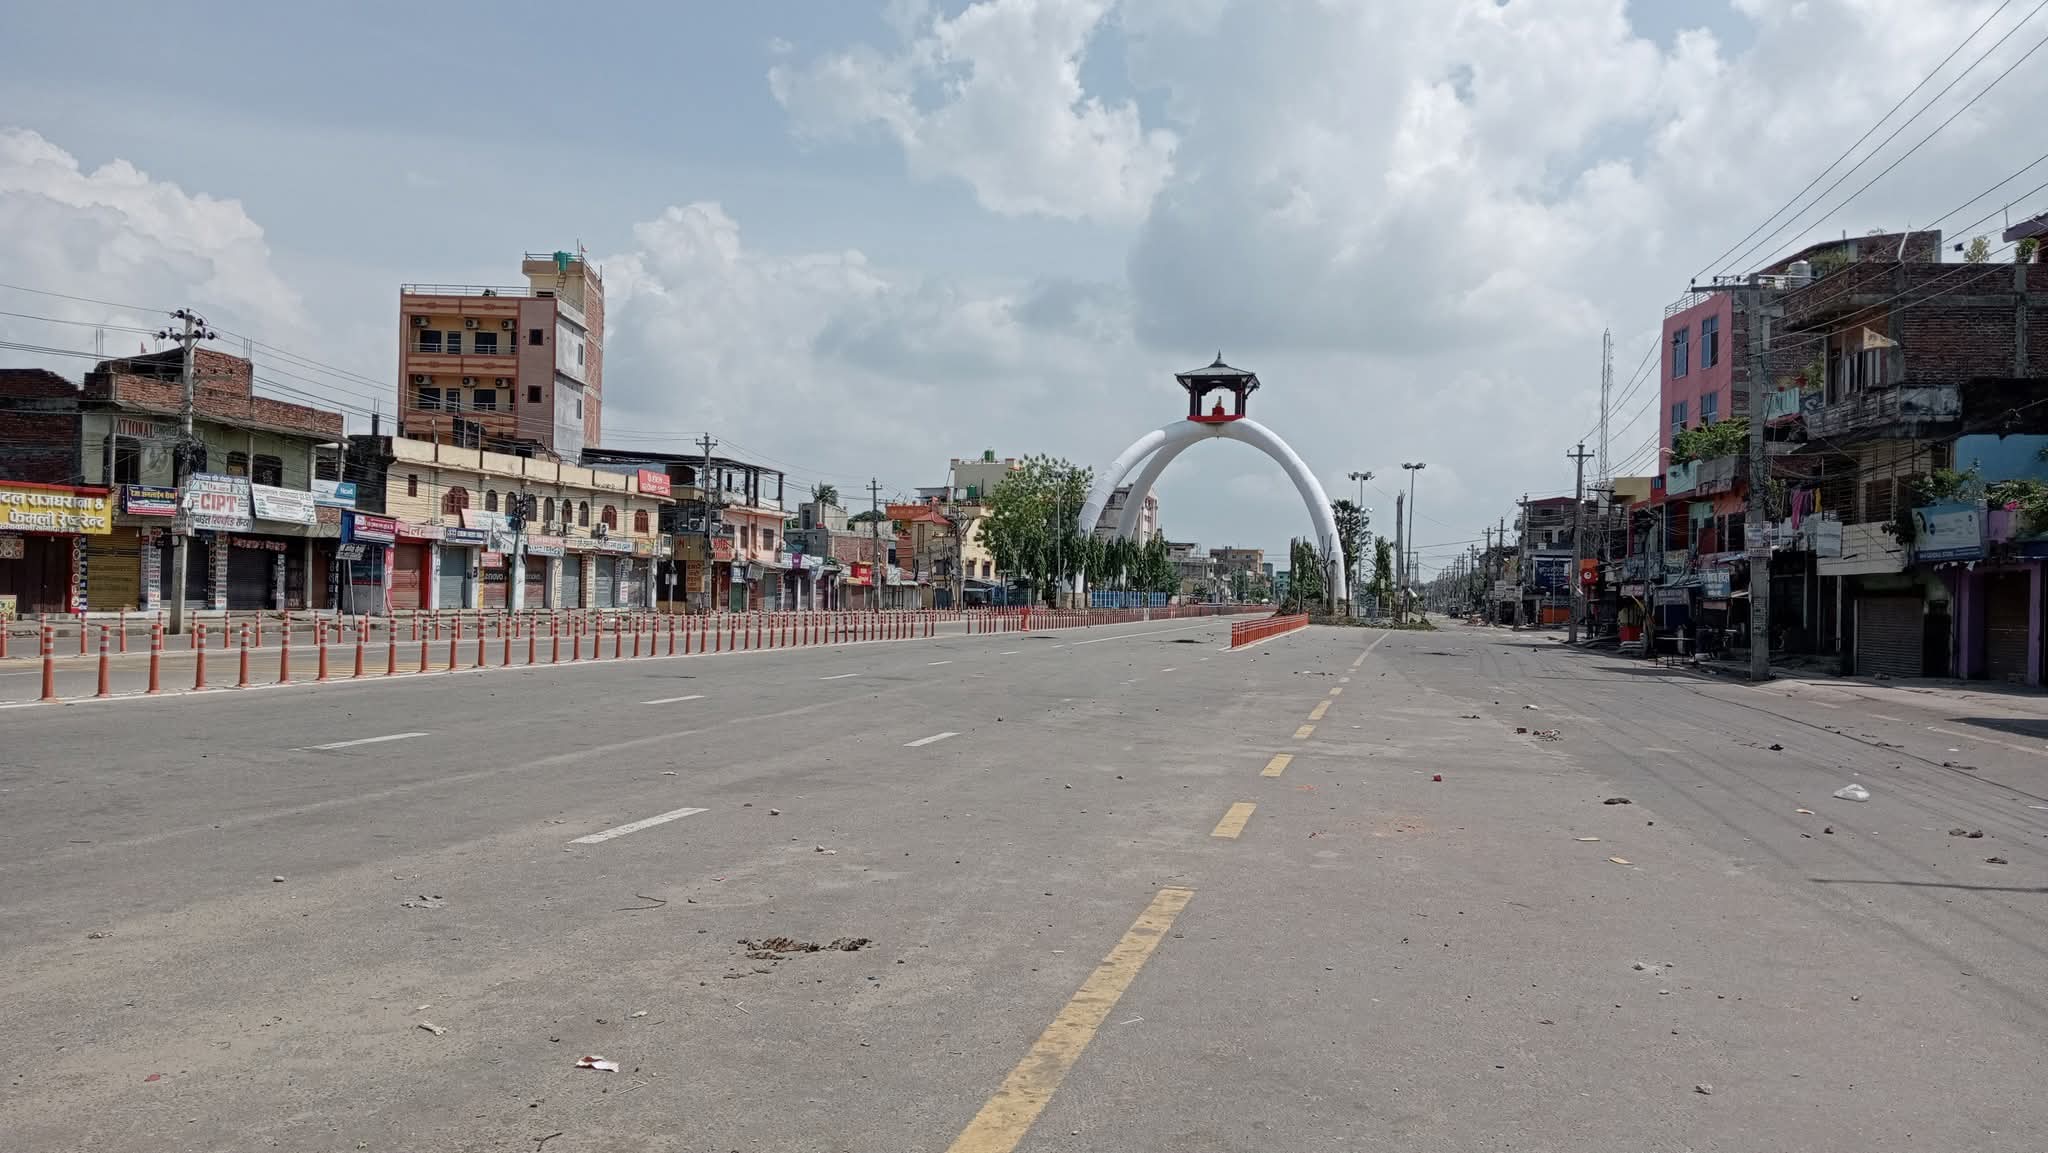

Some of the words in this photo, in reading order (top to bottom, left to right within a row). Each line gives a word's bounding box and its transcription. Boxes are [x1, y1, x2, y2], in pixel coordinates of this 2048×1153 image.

[0, 491, 25, 506] टल
[95, 498, 104, 510] &
[201, 494, 237, 513] CIPT
